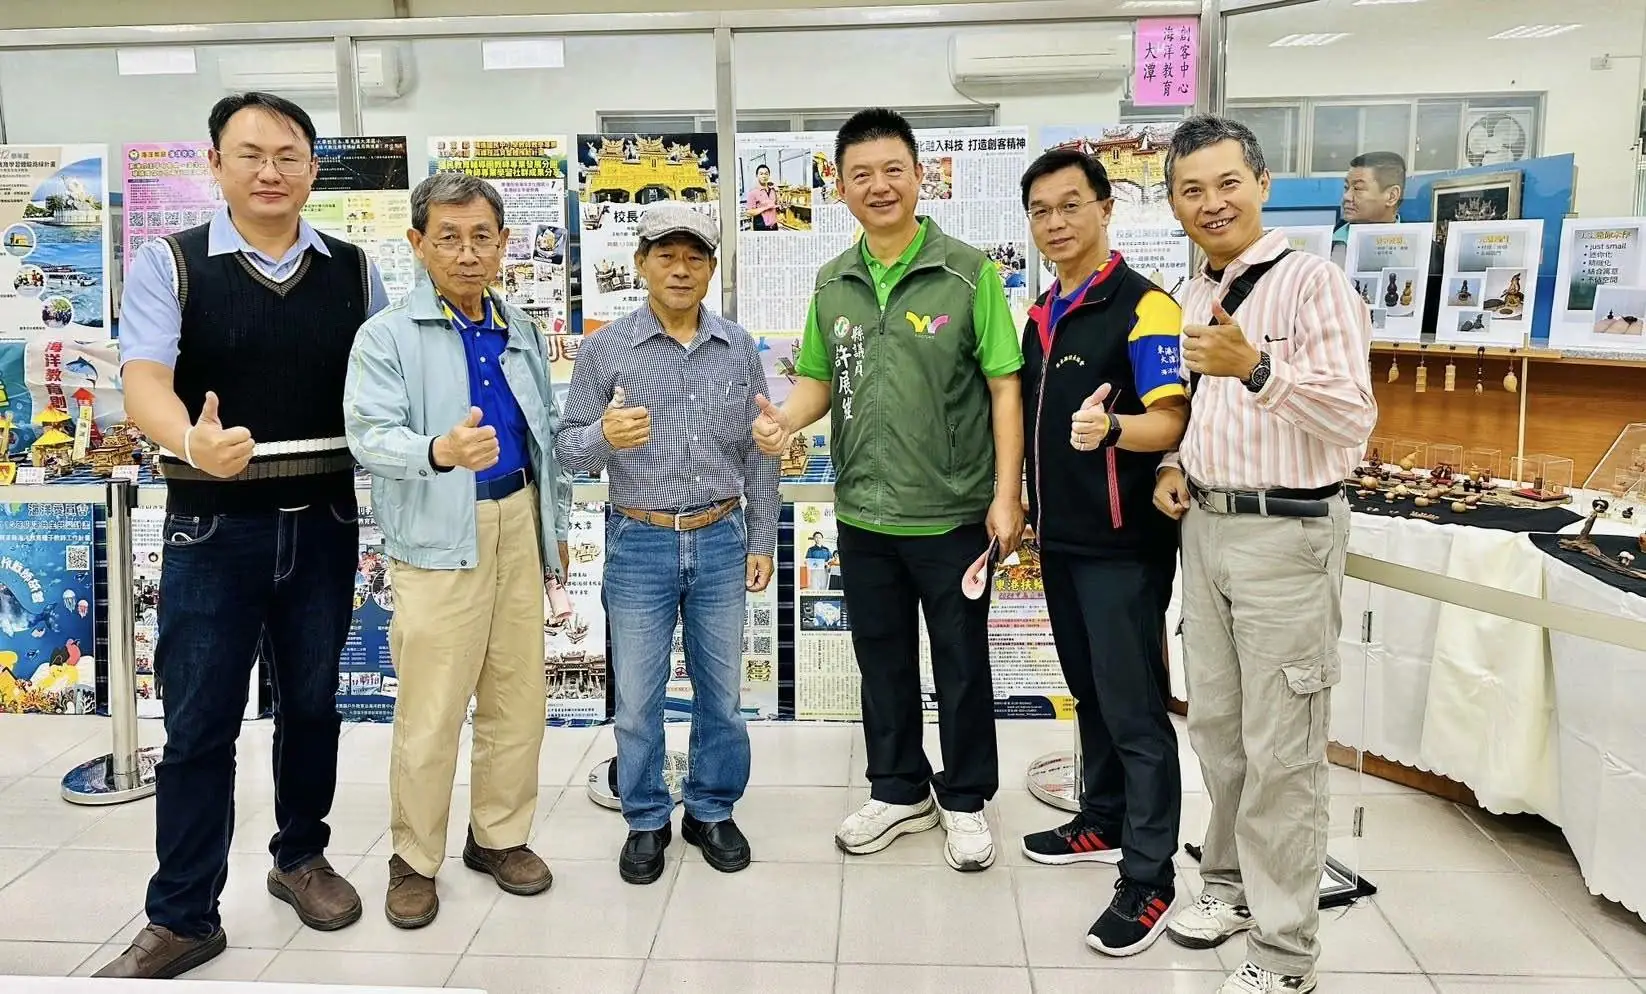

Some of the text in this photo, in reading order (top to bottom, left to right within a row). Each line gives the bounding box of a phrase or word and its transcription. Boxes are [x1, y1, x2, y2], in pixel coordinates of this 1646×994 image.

[1143, 41, 1157, 82] 大潭
[1163, 25, 1175, 97] 海洋教育
[1178, 25, 1191, 94] 創客中心
[968, 138, 1026, 151] 打造創客精神
[613, 210, 647, 224] 校長
[851, 324, 865, 377] 縣議員
